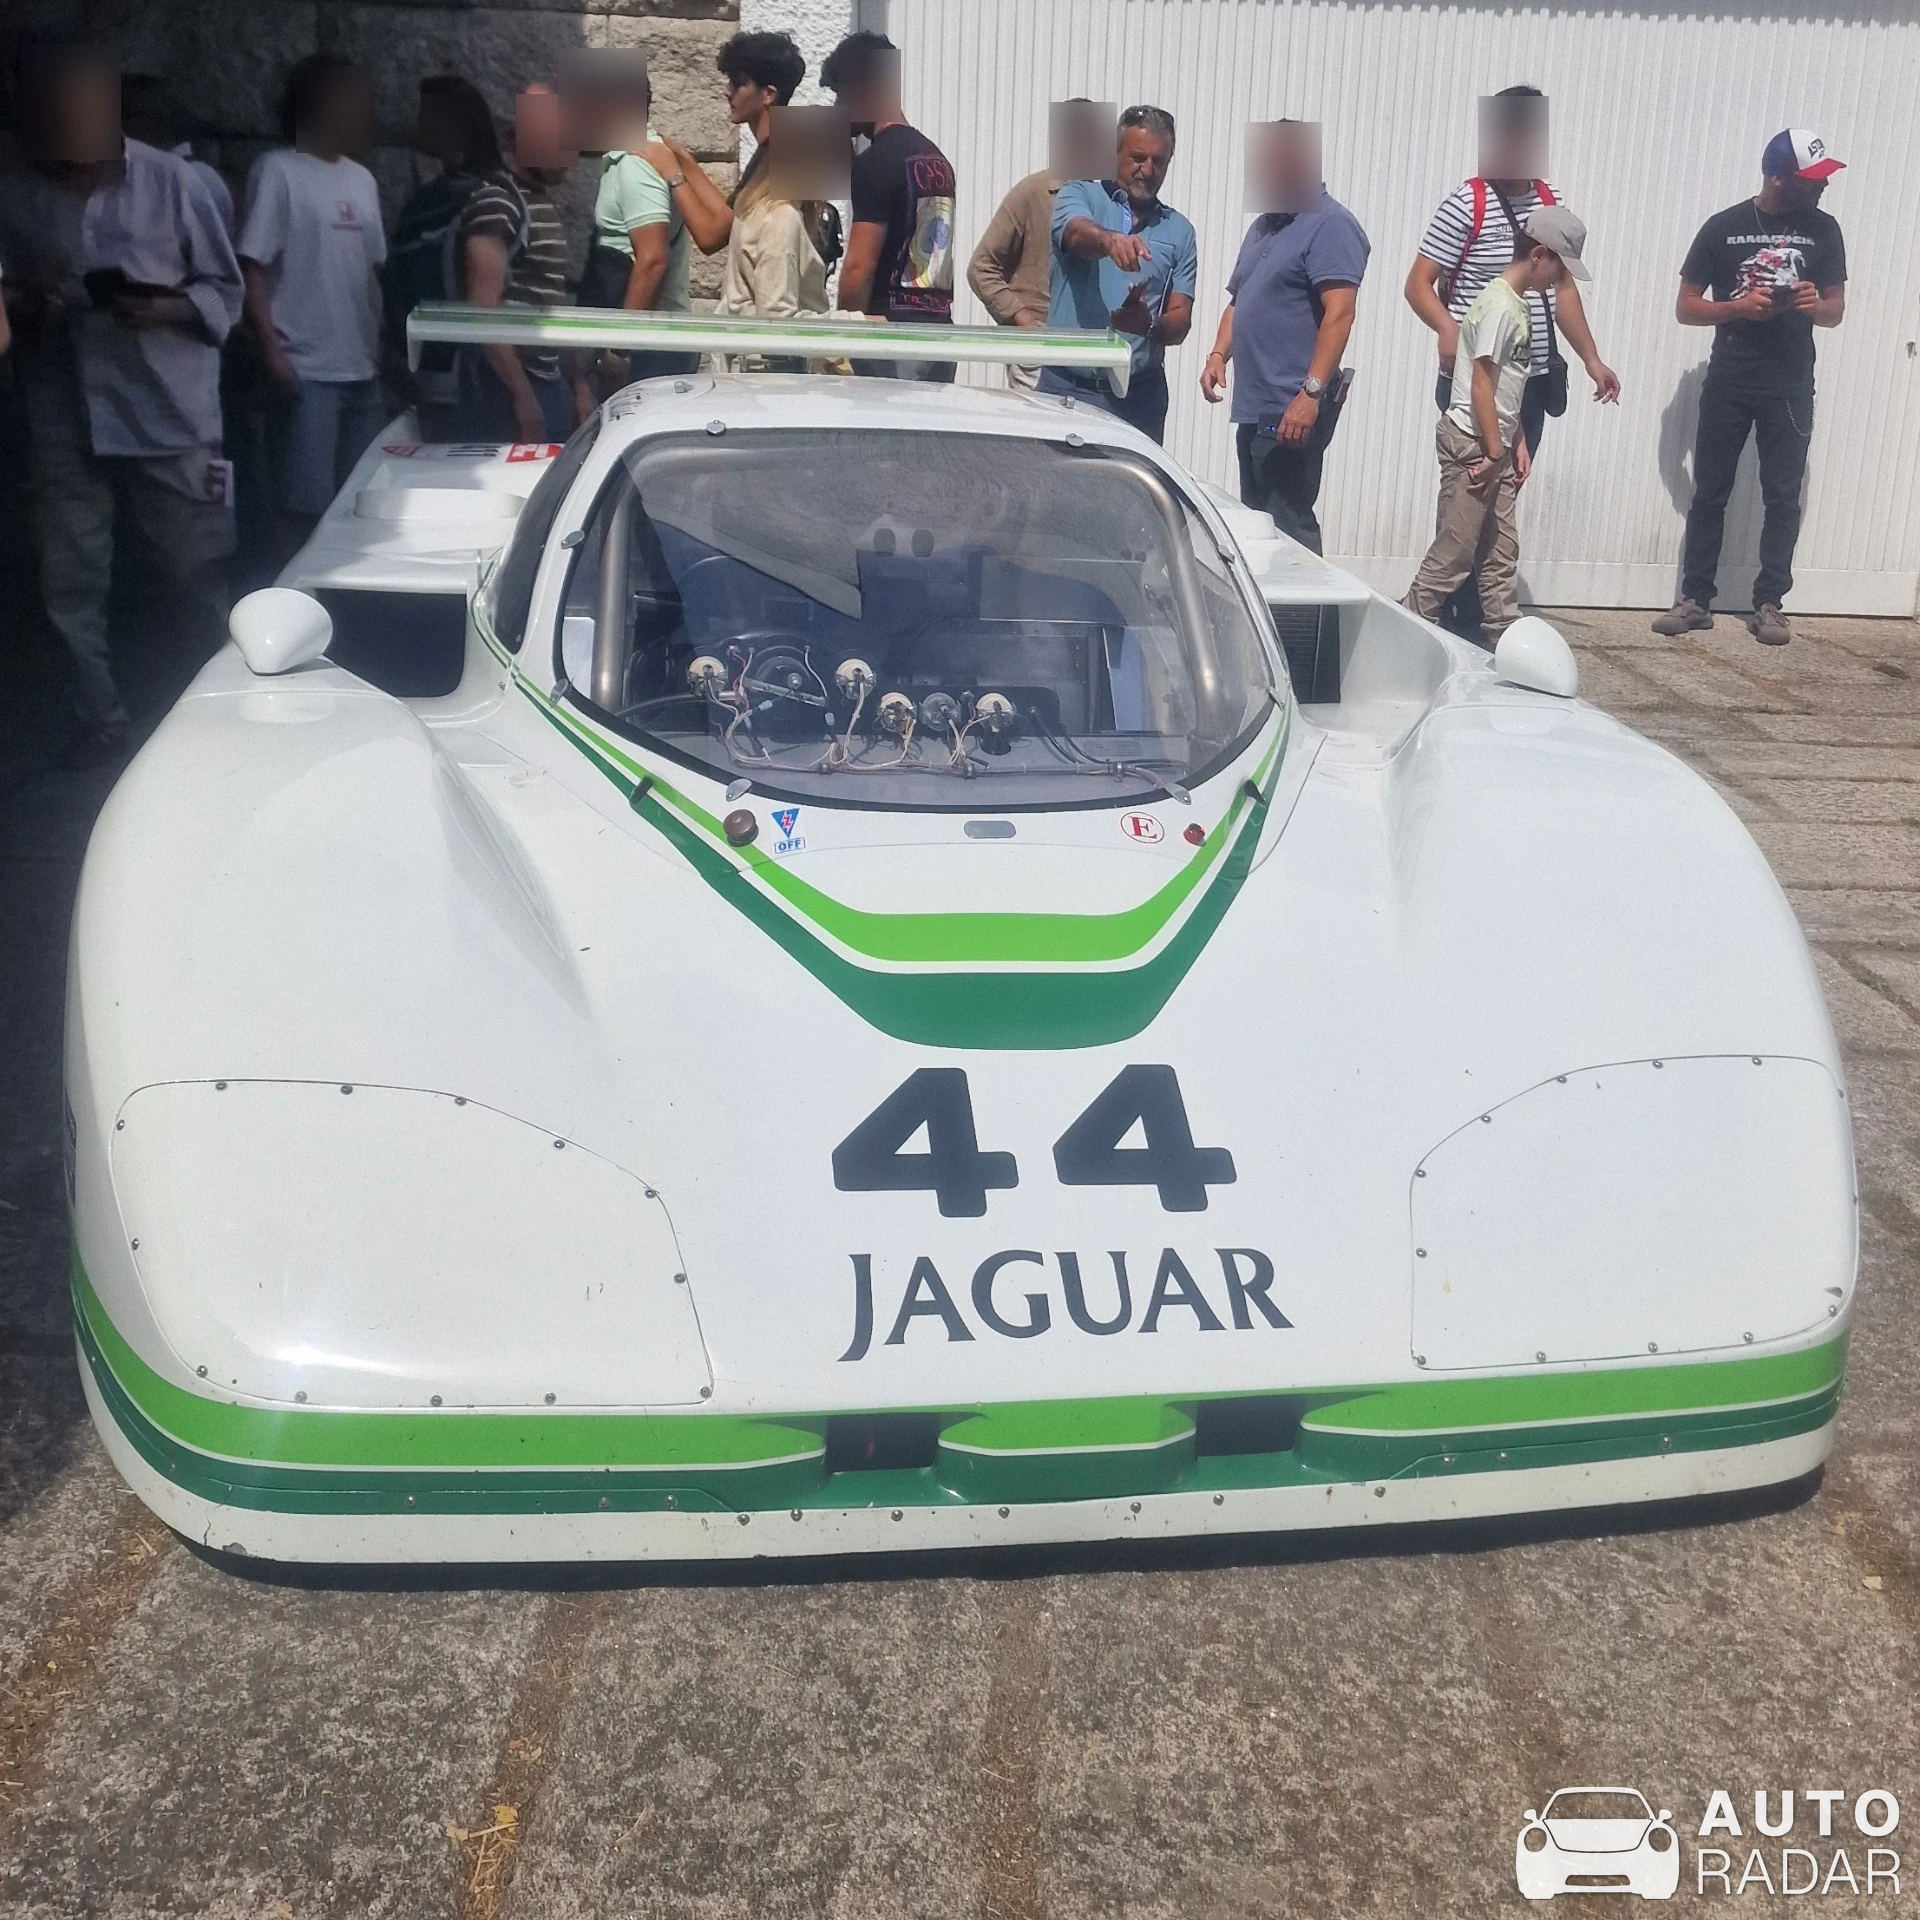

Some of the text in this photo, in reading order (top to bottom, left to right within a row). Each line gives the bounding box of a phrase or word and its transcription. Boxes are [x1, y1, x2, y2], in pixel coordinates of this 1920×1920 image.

[778, 839, 802, 851] OFF
[1127, 815, 1158, 839] E
[831, 1064, 1237, 1218] 44
[836, 1247, 1295, 1362] JAGUAR
